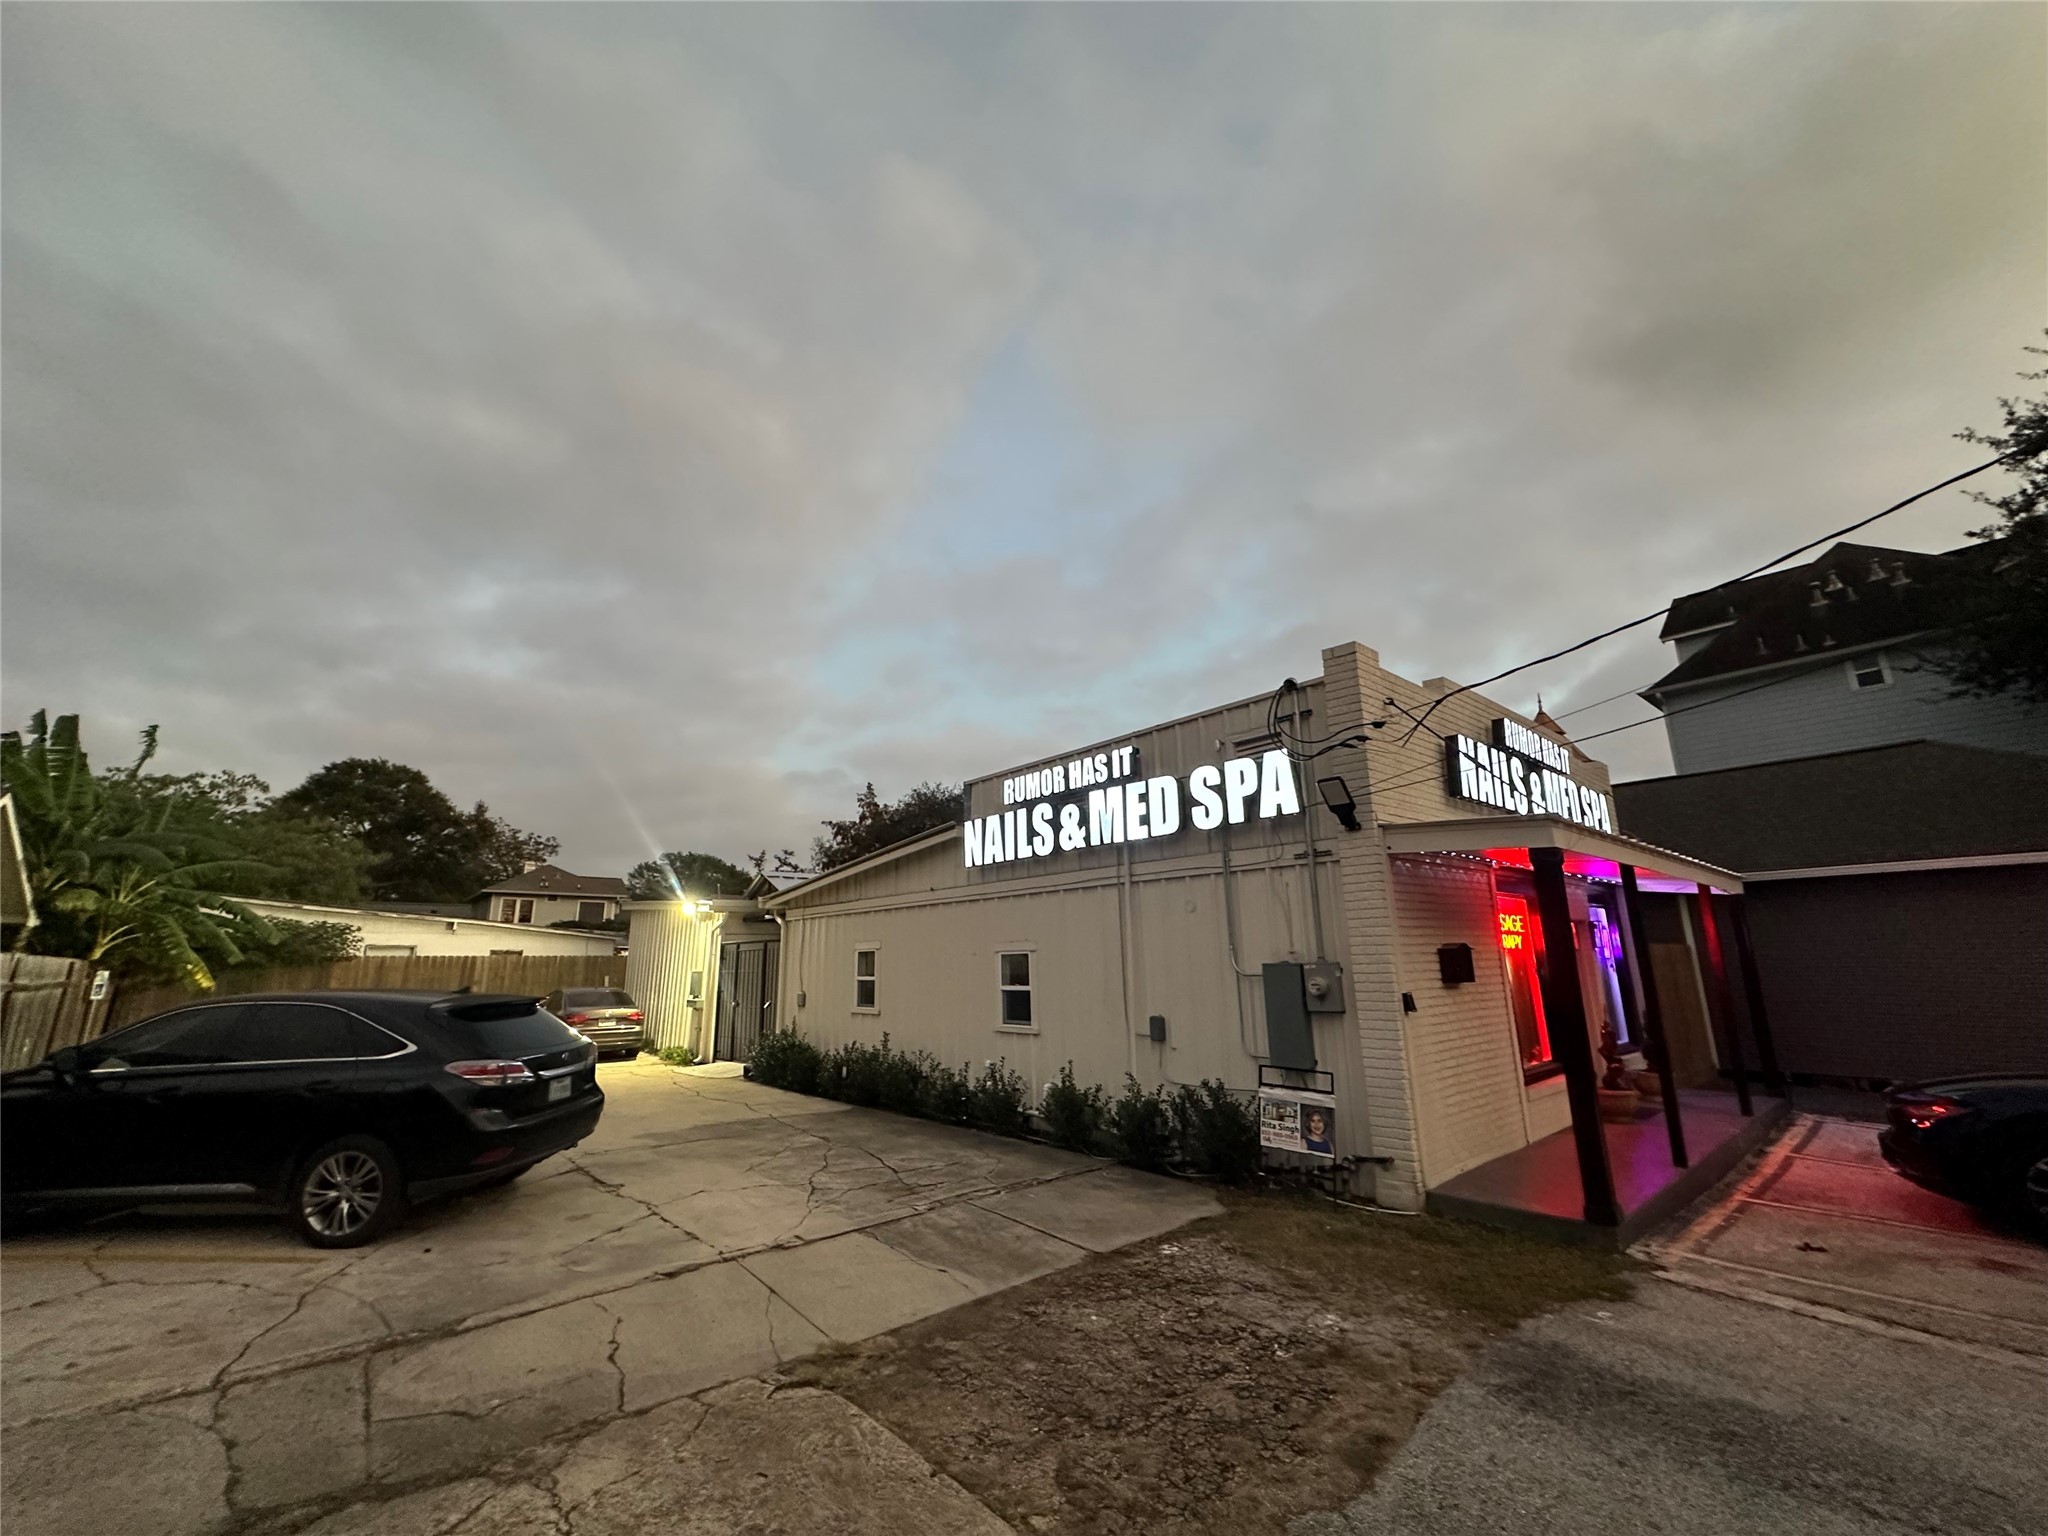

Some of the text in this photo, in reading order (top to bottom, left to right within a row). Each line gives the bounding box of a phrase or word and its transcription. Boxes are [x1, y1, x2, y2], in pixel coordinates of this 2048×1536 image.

[1003, 745, 1136, 805] RUMOR HAS IT
[1503, 717, 1570, 775] RUMOR HAS IT
[1189, 748, 1301, 831] SPA
[1457, 733, 1529, 816] NAILS
[1580, 785, 1612, 834] SPA
[1499, 913, 1525, 932] SAGE
[1261, 1120, 1300, 1134] Rita Singh
